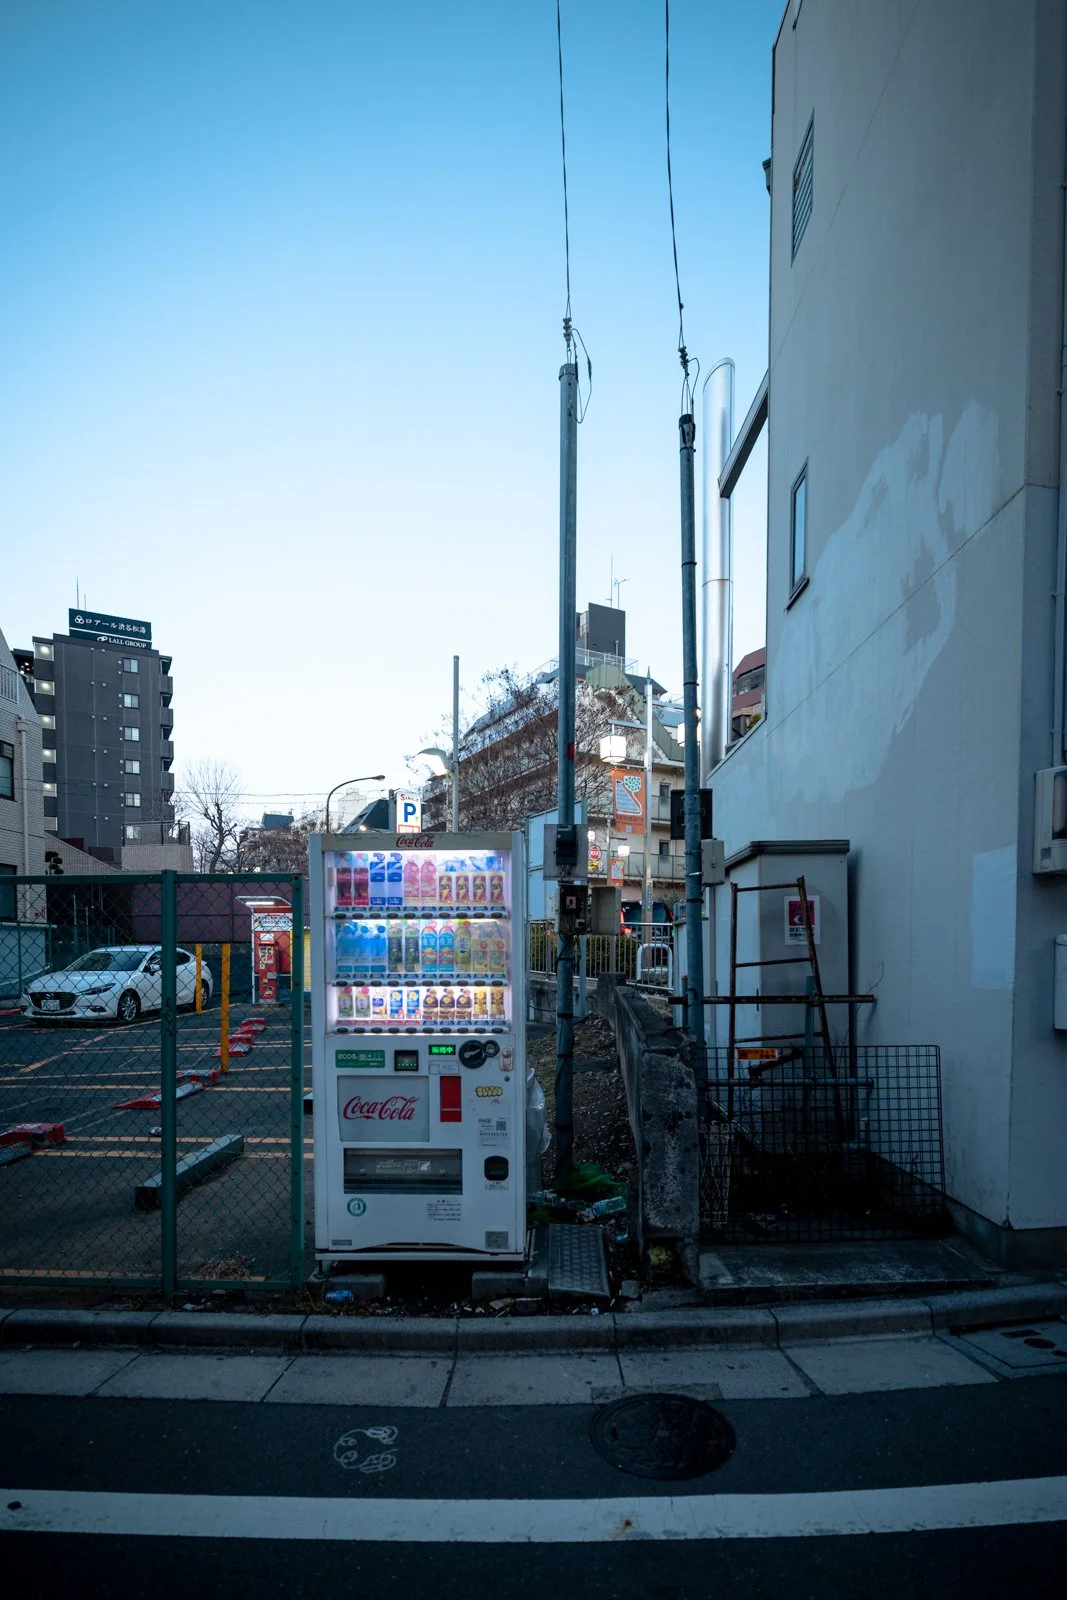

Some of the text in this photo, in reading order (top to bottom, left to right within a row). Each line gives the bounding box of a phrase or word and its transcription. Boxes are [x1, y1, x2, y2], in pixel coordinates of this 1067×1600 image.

[108, 637, 147, 648] LALL GROUP
[404, 802, 417, 823] P
[343, 1095, 420, 1121] Coca-Cola
